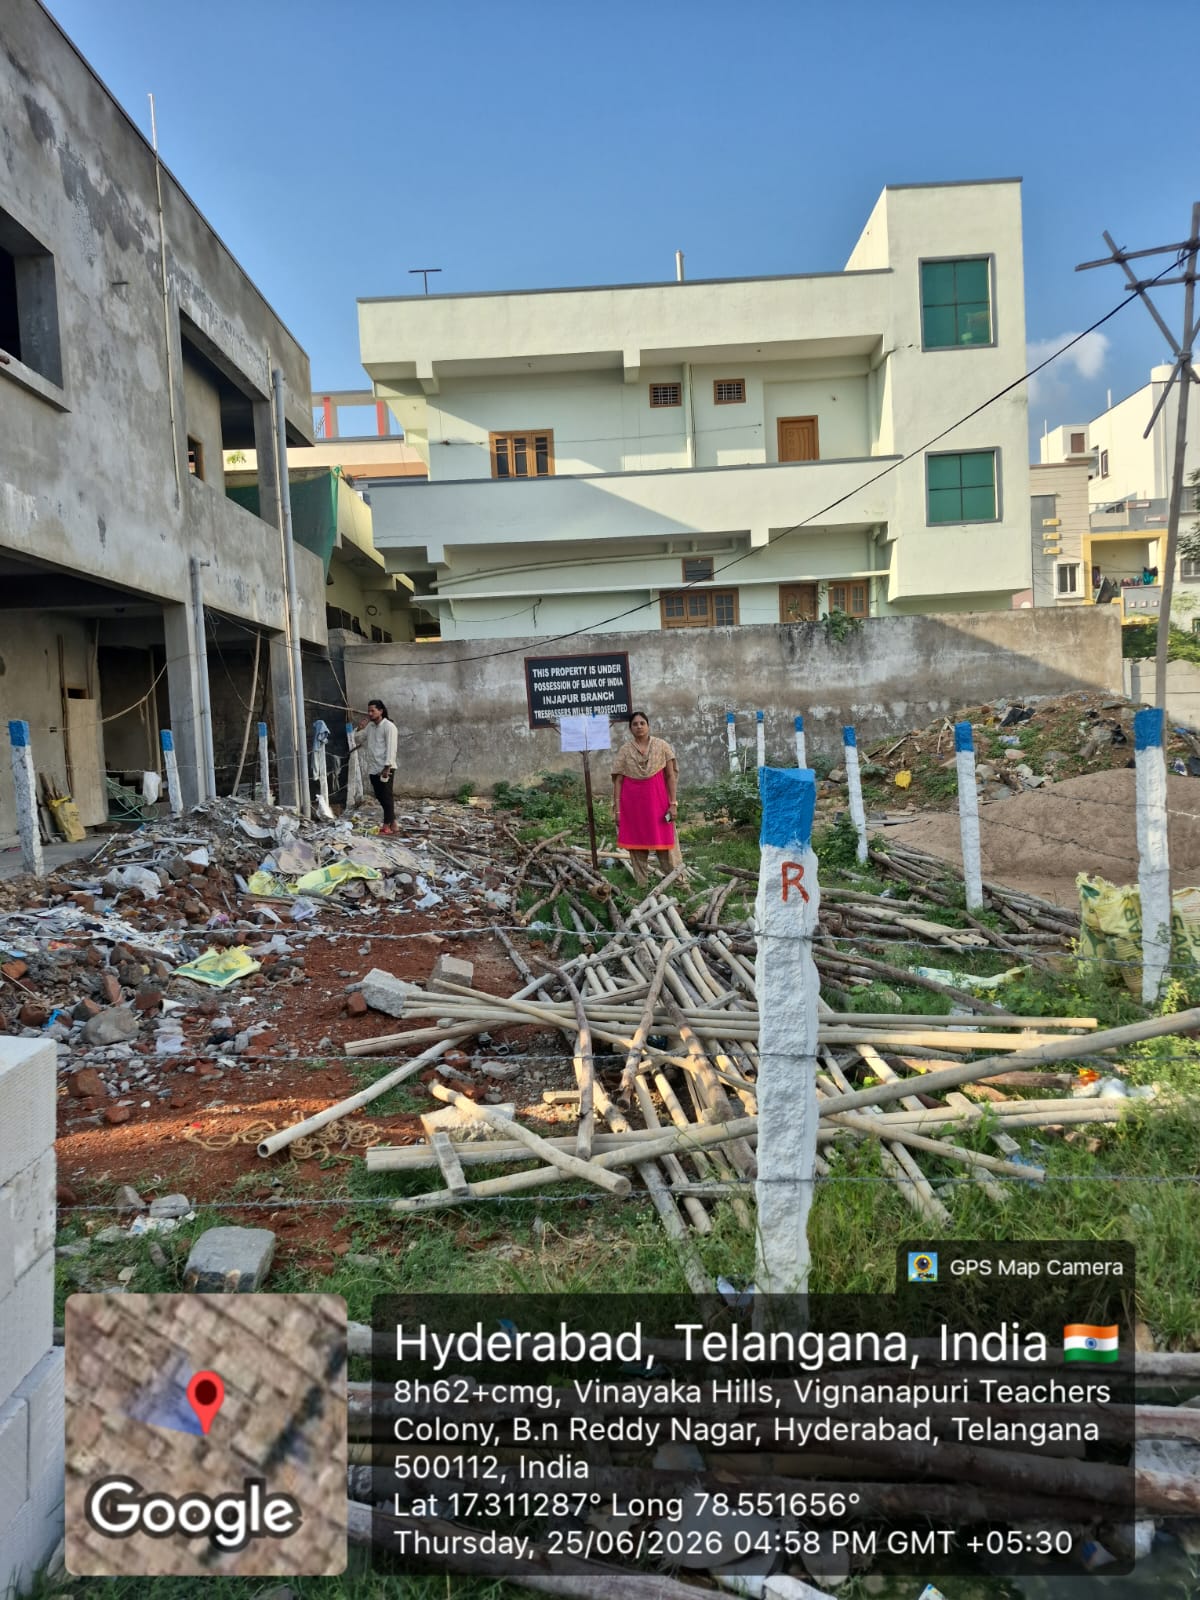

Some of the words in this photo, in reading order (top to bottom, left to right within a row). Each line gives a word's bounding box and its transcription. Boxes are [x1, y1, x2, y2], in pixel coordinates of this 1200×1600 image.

[532, 668, 550, 678] THIS
[551, 666, 587, 677] PROPERTY
[588, 665, 596, 674] IS
[597, 664, 621, 674] UNDER
[533, 681, 571, 692] POSSESSION
[572, 680, 581, 689] OF
[581, 679, 598, 688] BANK
[598, 678, 606, 687] OF
[607, 677, 624, 687] INDIA
[542, 694, 579, 705] INJAPUR
[580, 691, 615, 702] BRANCH
[533, 708, 572, 719] TRESPASSERS
[571, 707, 585, 716] WILL
[586, 706, 593, 715] BE
[594, 704, 628, 714] PROSECUTED
[781, 861, 810, 904] R
